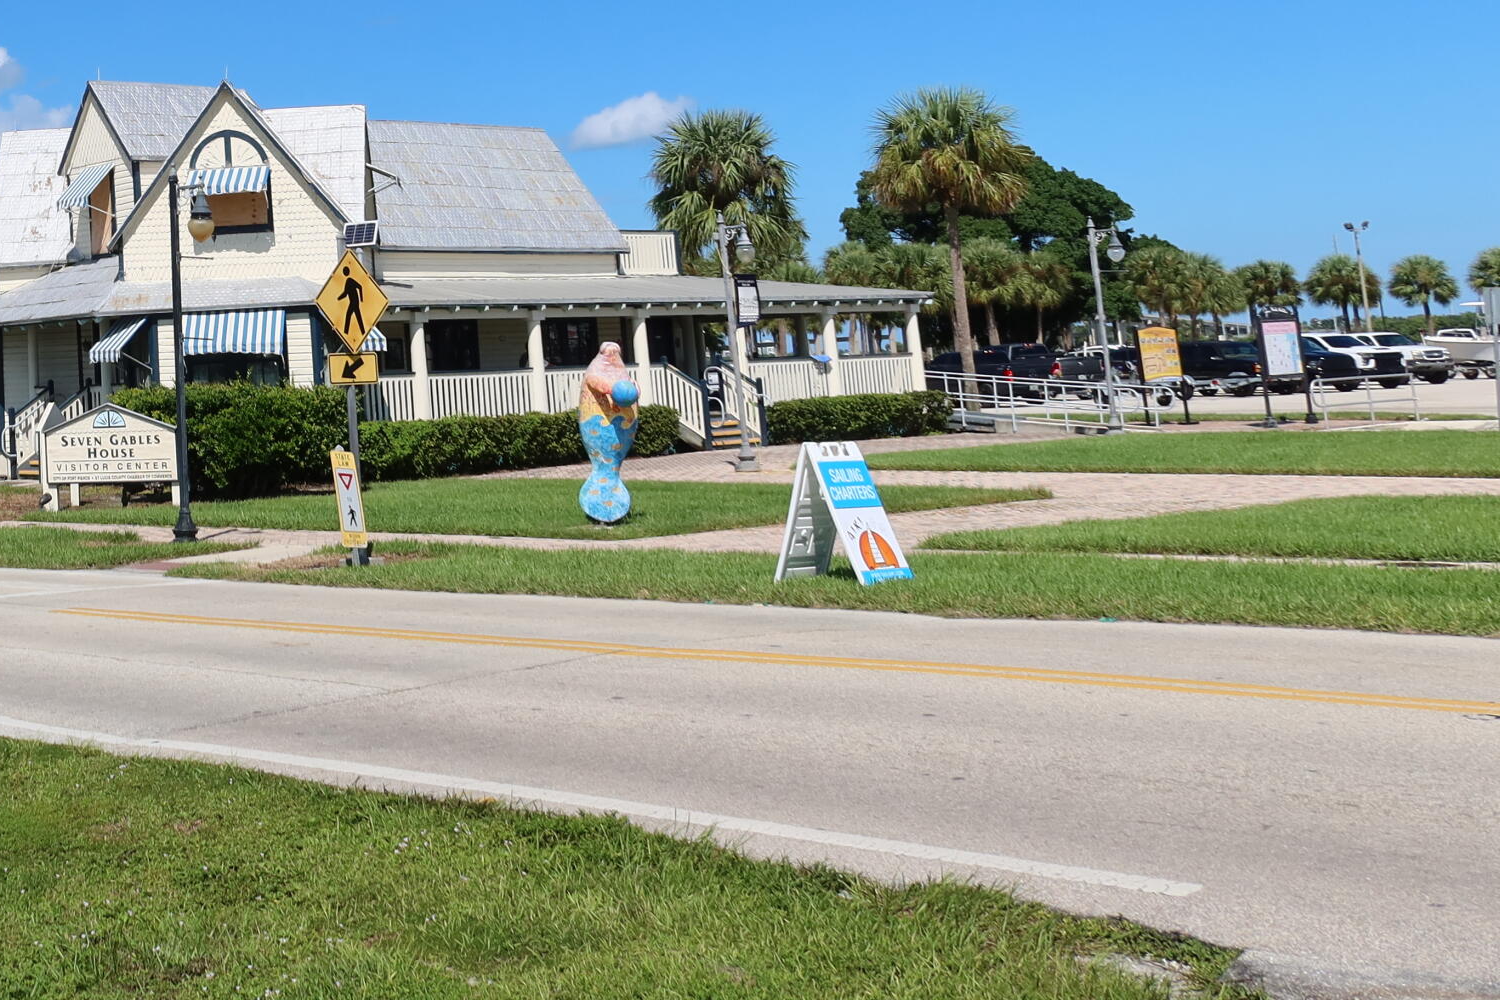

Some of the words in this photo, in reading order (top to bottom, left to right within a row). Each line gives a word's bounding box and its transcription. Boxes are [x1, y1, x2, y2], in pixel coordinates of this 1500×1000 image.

[60, 435, 102, 447] SEVEN
[109, 434, 161, 446] GABLES
[87, 448, 135, 459] HOUSE
[56, 463, 109, 472] VISITOR
[117, 462, 168, 471] CENTER
[828, 468, 864, 483] SAILING
[830, 485, 876, 500] CHARTERS
